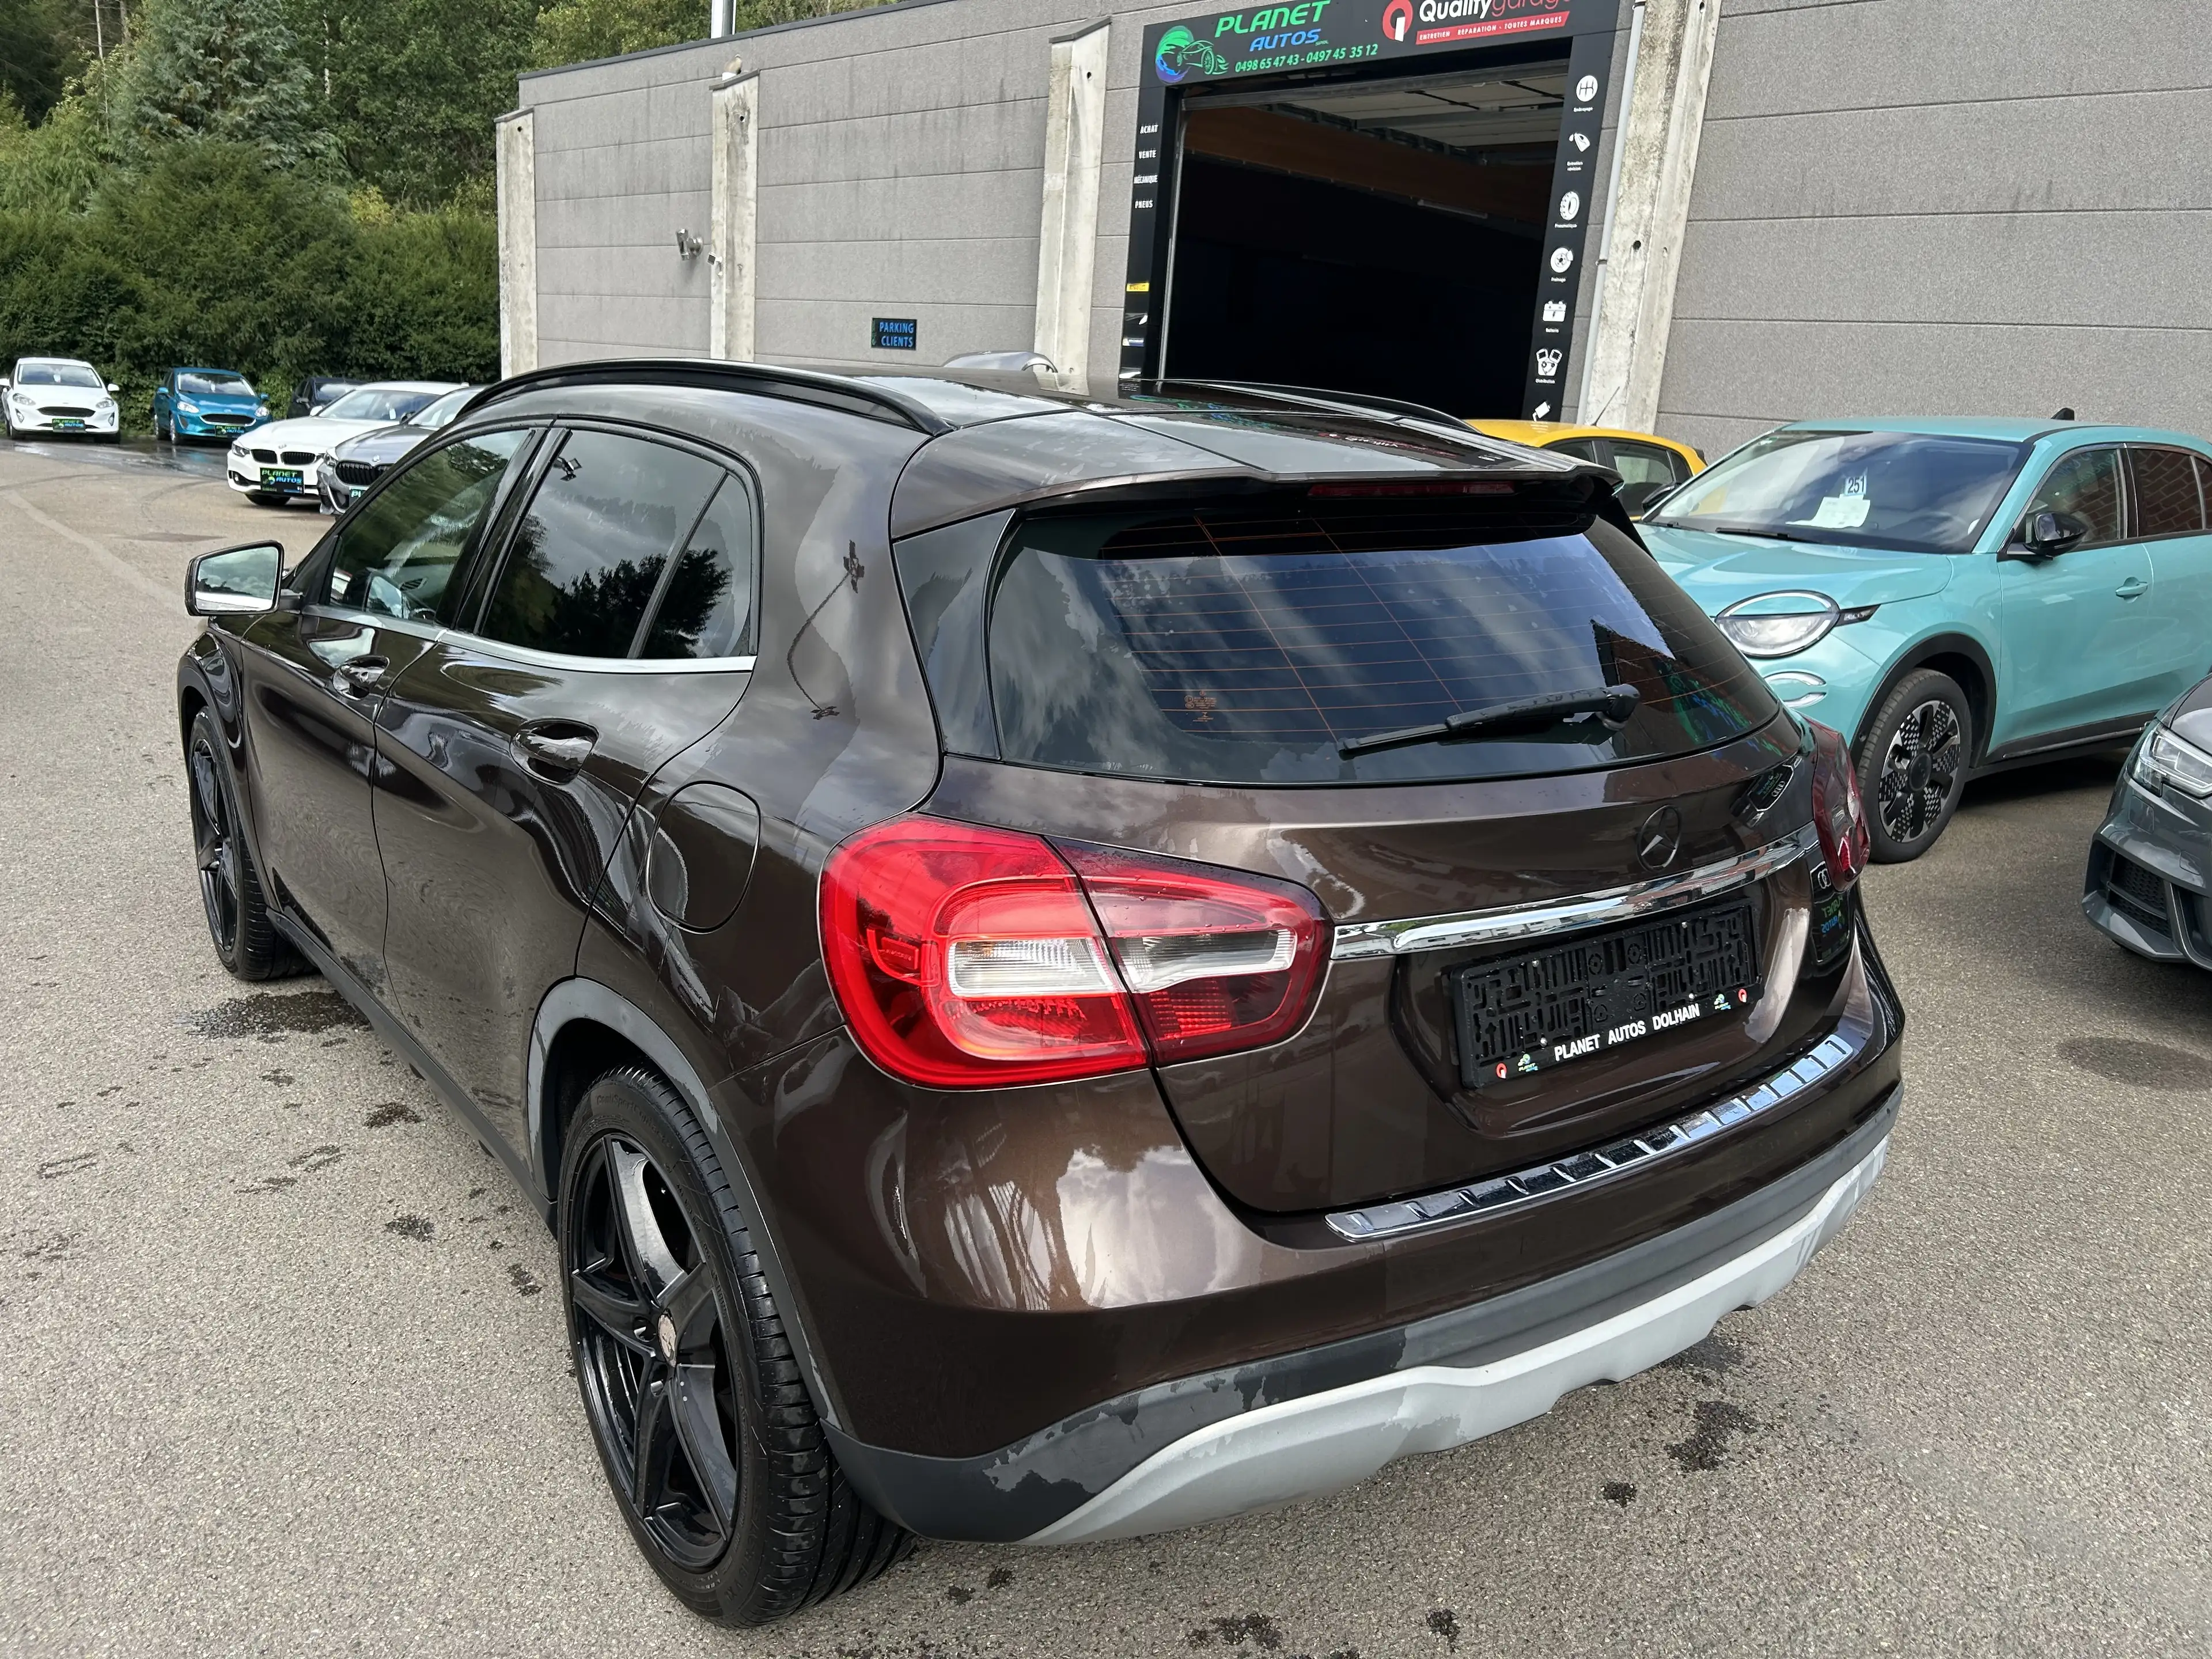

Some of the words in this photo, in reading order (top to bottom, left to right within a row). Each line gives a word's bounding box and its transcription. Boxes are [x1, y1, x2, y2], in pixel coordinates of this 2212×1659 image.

[1215, 0, 1331, 37] PLANET
[1419, 31, 1450, 41] ENTRETIEN
[1457, 25, 1497, 36] REPARATION
[1504, 20, 1527, 30] TOUTES
[1529, 16, 1562, 26] MARQUES
[1249, 28, 1321, 52] AUTOS
[1235, 59, 1257, 73] 0498
[1259, 57, 1272, 69] 65
[1273, 56, 1285, 67] 47
[1286, 54, 1300, 66] 43
[1306, 50, 1332, 63] 0497
[1332, 47, 1346, 59] 45
[1349, 46, 1363, 58] 35
[1365, 44, 1378, 56] 12
[1140, 124, 1158, 134] ACHAT
[1138, 150, 1157, 159] VENTE
[1135, 199, 1153, 209] PNEUS
[879, 321, 914, 334] PARKING
[881, 335, 914, 347] CLIENTS
[262, 469, 298, 478] PLANET
[1847, 475, 1865, 494] 251
[1554, 1033, 1601, 1062] PLANET
[1608, 1020, 1646, 1046] AUTOS
[1652, 1003, 1700, 1031] DOLHAIN
